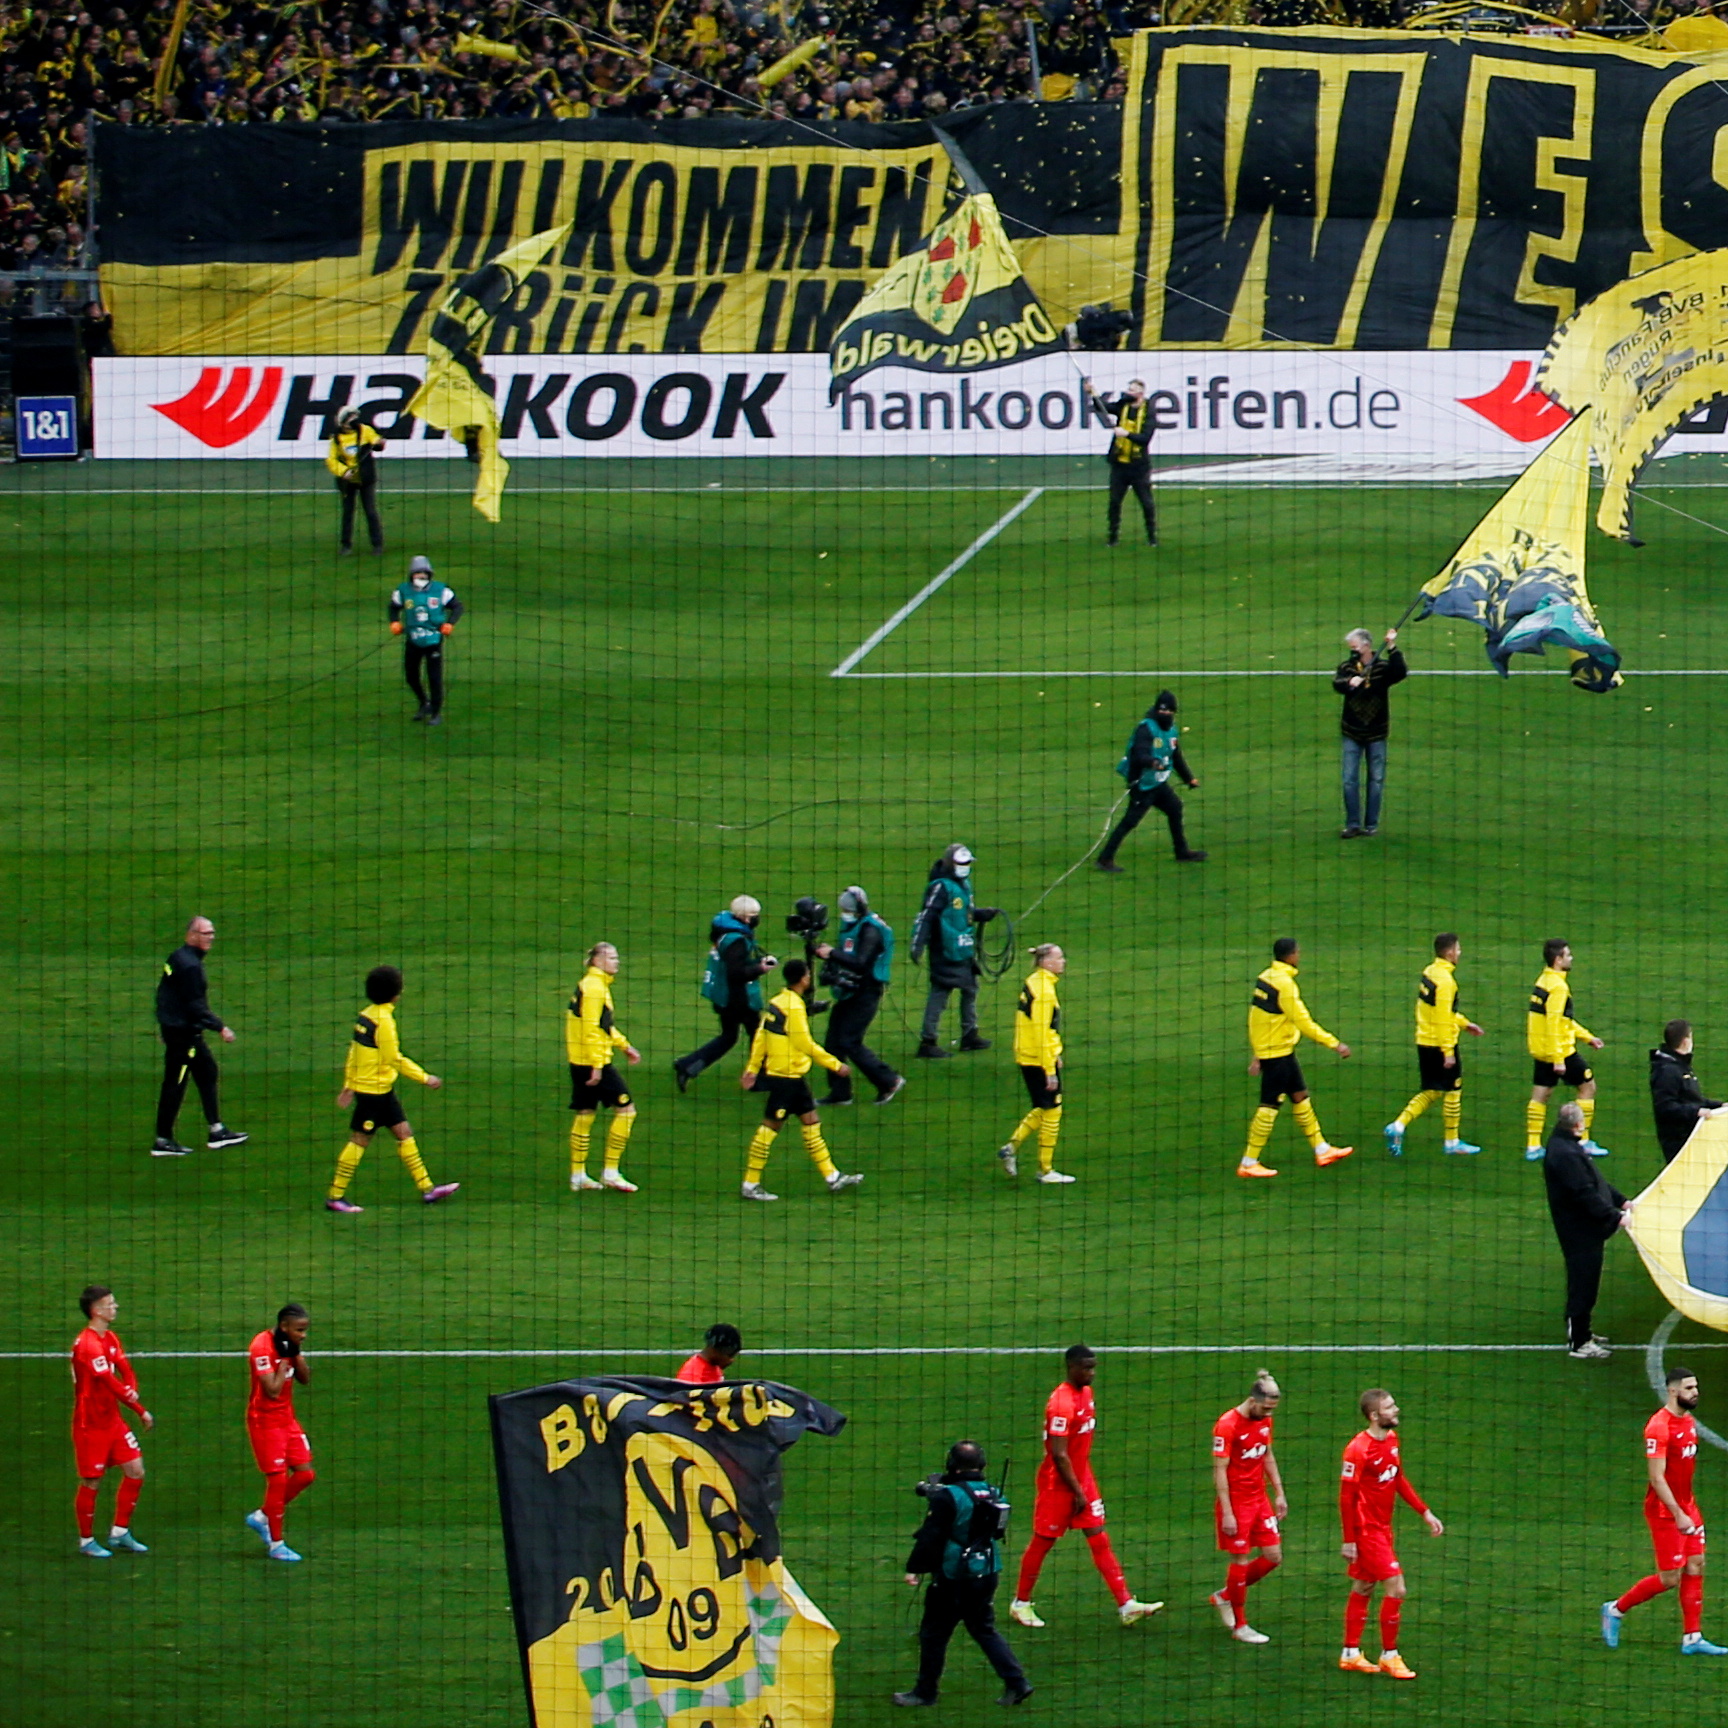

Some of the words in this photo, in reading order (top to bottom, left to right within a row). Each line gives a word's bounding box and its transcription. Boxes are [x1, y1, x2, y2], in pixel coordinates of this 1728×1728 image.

[22, 410, 70, 441] 1&1
[279, 372, 788, 441] HaKOOK
[841, 375, 1402, 431] hankookeifen.de
[666, 1585, 721, 1652] 09
